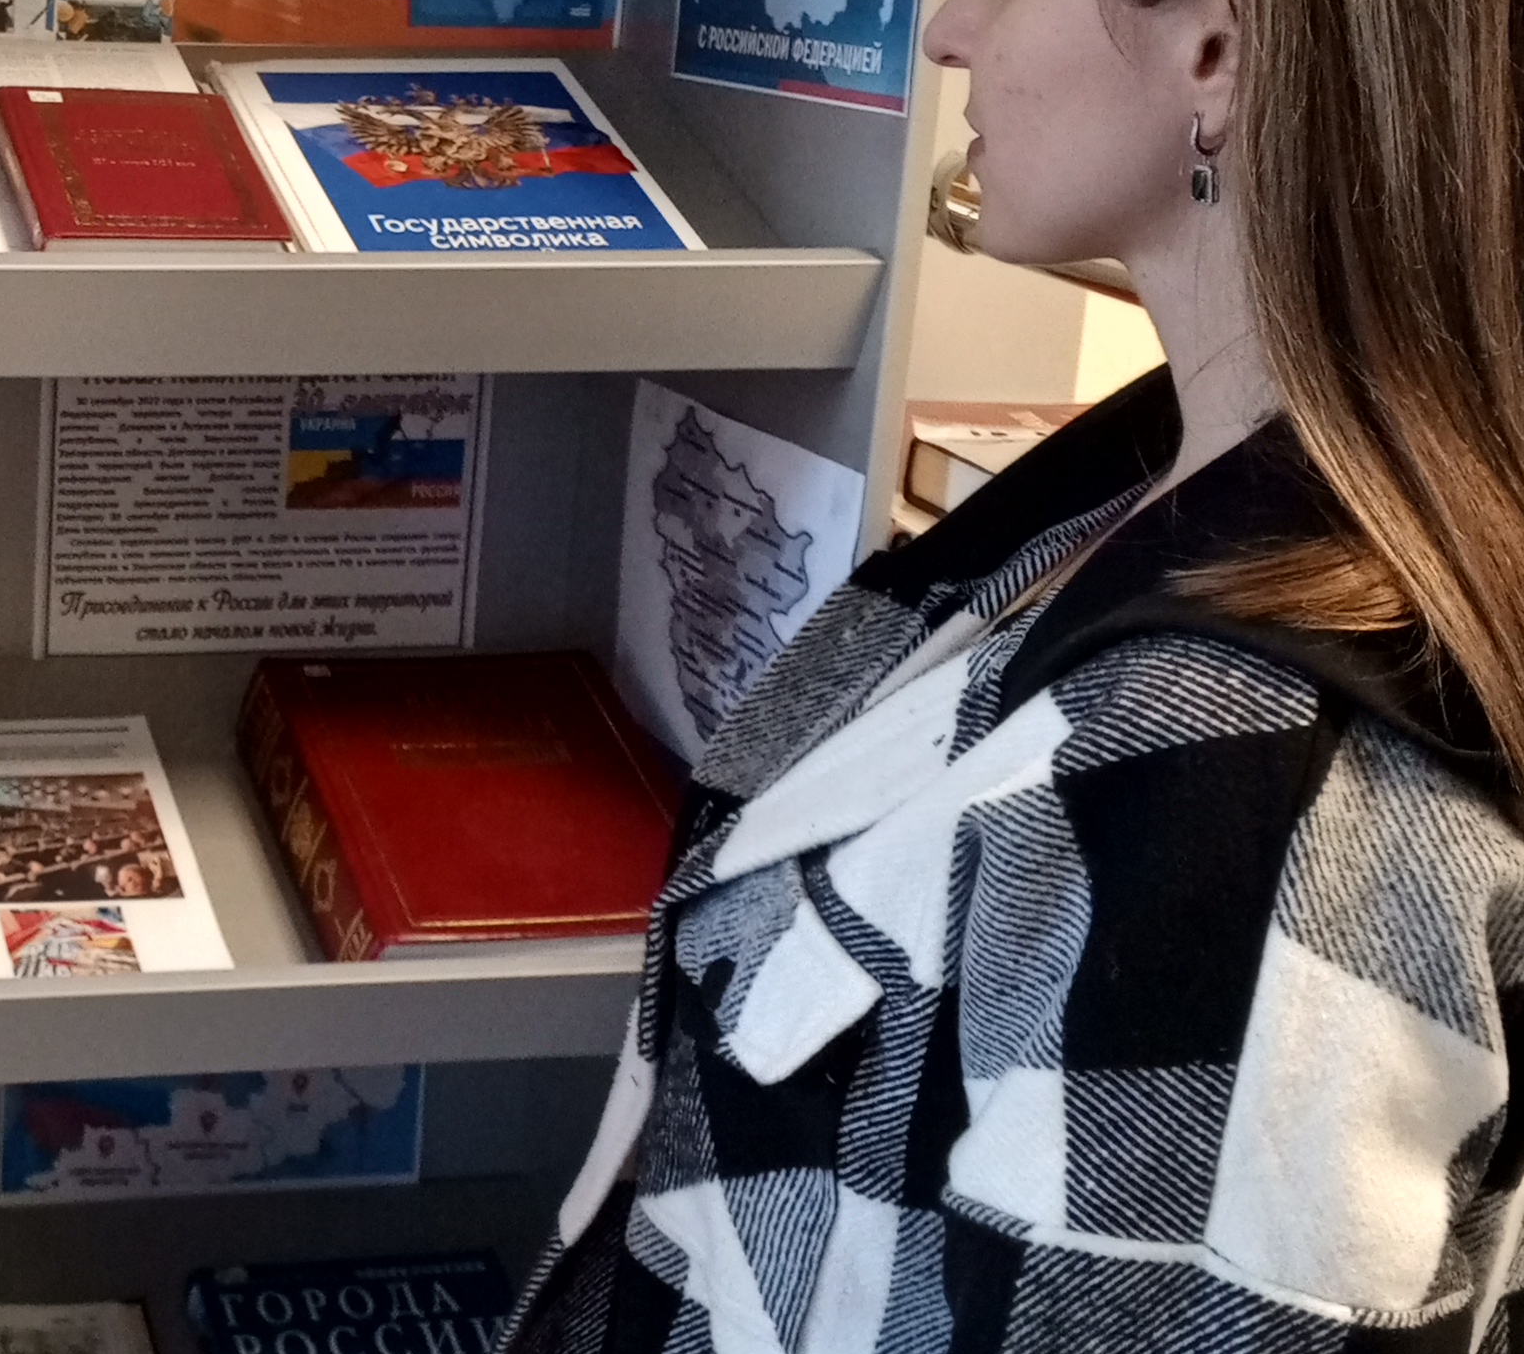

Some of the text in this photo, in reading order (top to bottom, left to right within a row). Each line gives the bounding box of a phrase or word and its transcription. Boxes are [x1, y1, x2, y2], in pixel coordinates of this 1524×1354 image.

[698, 25, 884, 76] С РОССИЙСКОЙ ФЕДЕРАЦИЕЙ
[367, 212, 643, 236] Государственная
[429, 228, 609, 250] символика
[212, 588, 274, 613] России
[276, 590, 308, 611] для
[136, 624, 188, 642] стало
[219, 1280, 463, 1328] ГОРОДА
